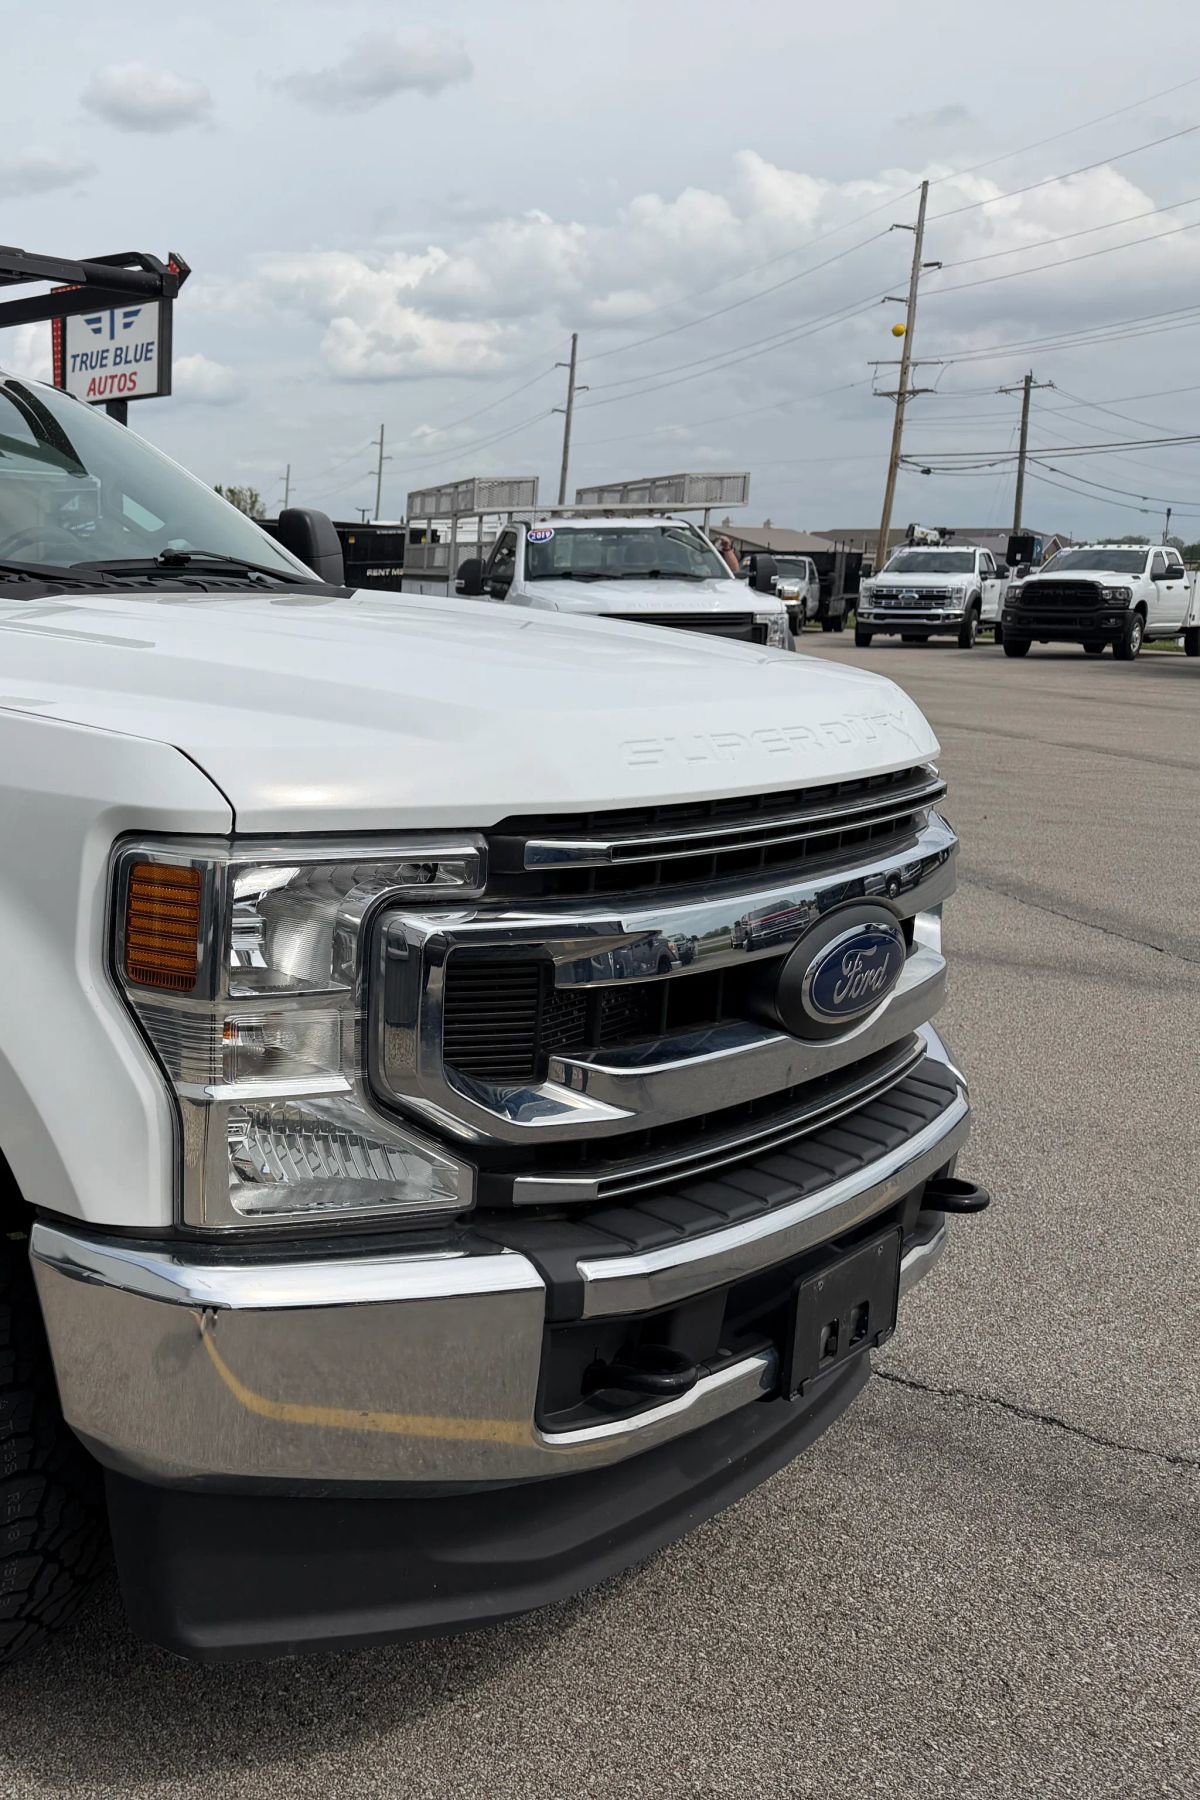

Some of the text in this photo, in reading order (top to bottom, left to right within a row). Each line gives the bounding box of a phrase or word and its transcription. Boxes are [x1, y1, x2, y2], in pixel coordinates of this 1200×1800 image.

[70, 341, 155, 373] TRUE BLUE
[86, 371, 138, 397] AUTOS
[366, 568, 391, 577] RENT
[618, 725, 824, 766] SUPER
[833, 944, 890, 1005] Ford
